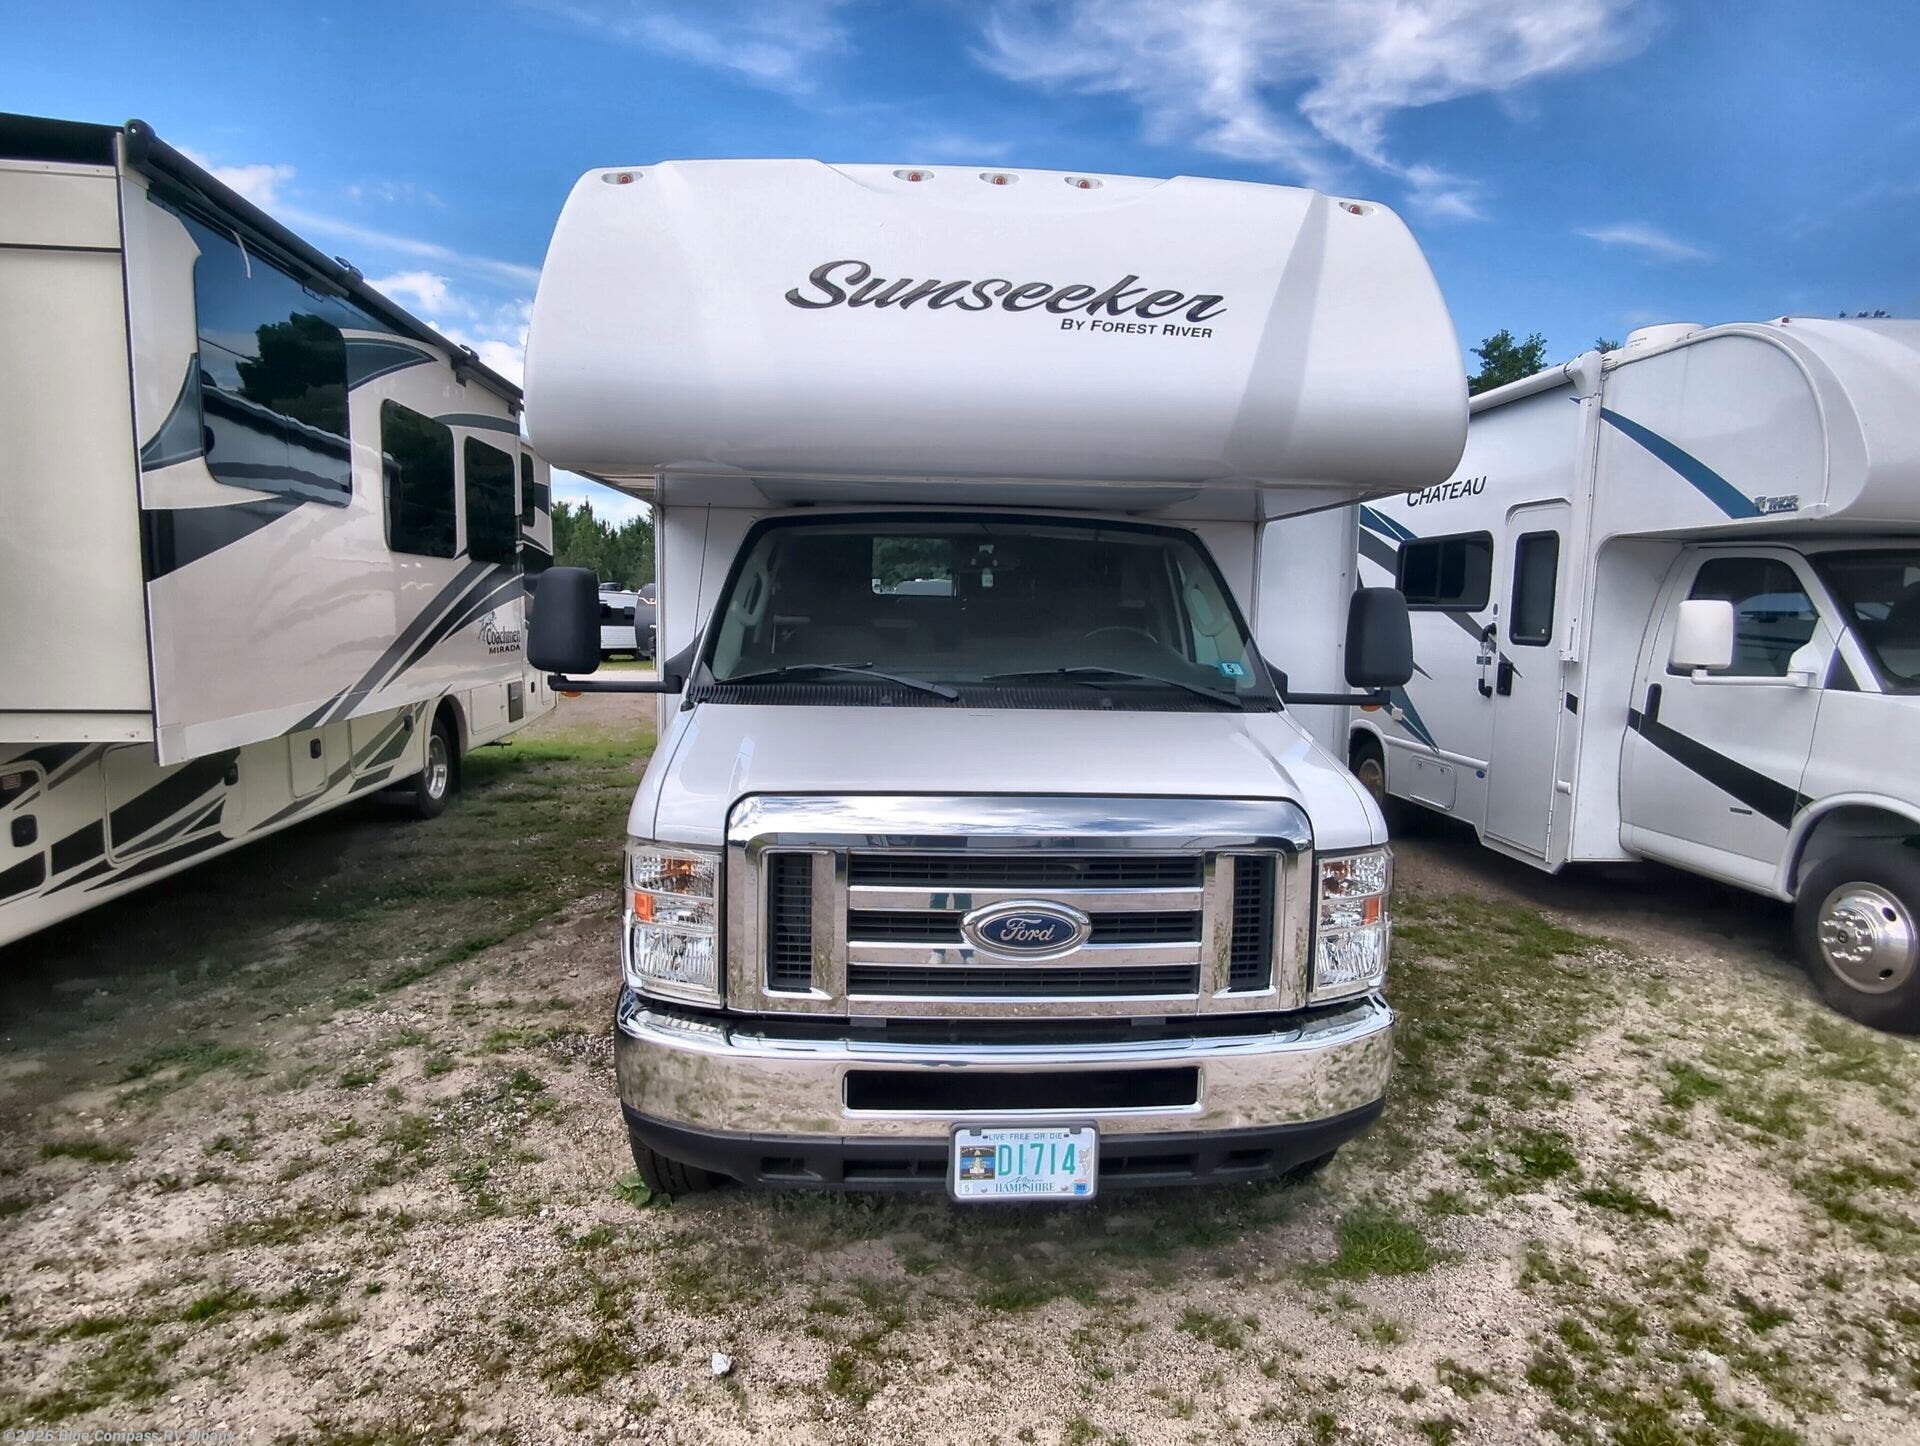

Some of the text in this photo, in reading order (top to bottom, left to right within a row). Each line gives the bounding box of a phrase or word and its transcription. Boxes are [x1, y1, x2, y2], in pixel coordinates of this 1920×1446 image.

[785, 260, 1228, 322] Sunseeker
[1406, 475, 1487, 507] CHATEAU
[488, 644, 521, 655] MIRADA
[1227, 664, 1235, 673] 5
[1000, 917, 1056, 942] Ford
[988, 1133, 1005, 1141] LIVE
[1050, 1132, 1063, 1140] DIE
[995, 1182, 1056, 1193] HAMPSHIRE
